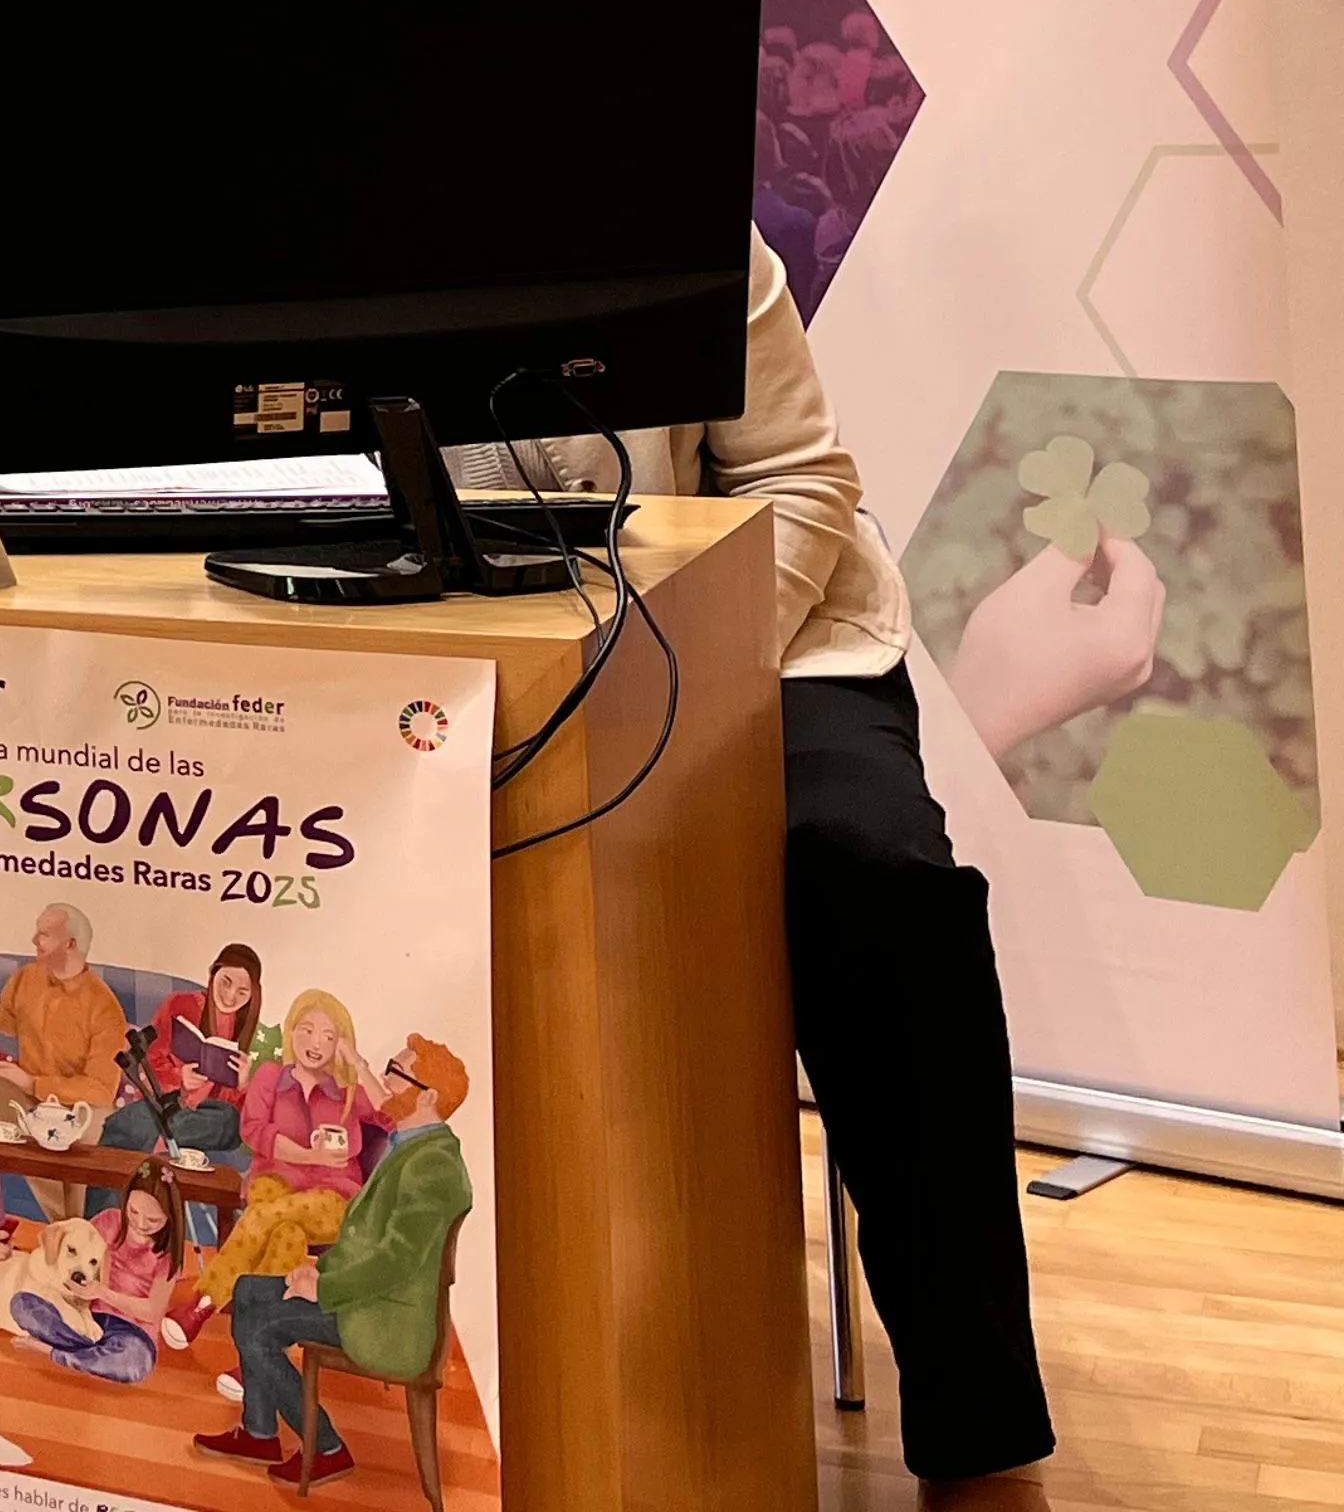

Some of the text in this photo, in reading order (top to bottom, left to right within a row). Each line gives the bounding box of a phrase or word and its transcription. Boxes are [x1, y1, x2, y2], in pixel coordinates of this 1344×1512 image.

[167, 694, 284, 715] Fundación feder
[17, 742, 118, 770] mundial
[128, 747, 160, 774] de
[170, 750, 204, 778] las
[134, 860, 211, 892] Raras
[220, 870, 321, 910] 2025
[14, 1485, 65, 1510] hablar
[68, 1498, 89, 1512] de
